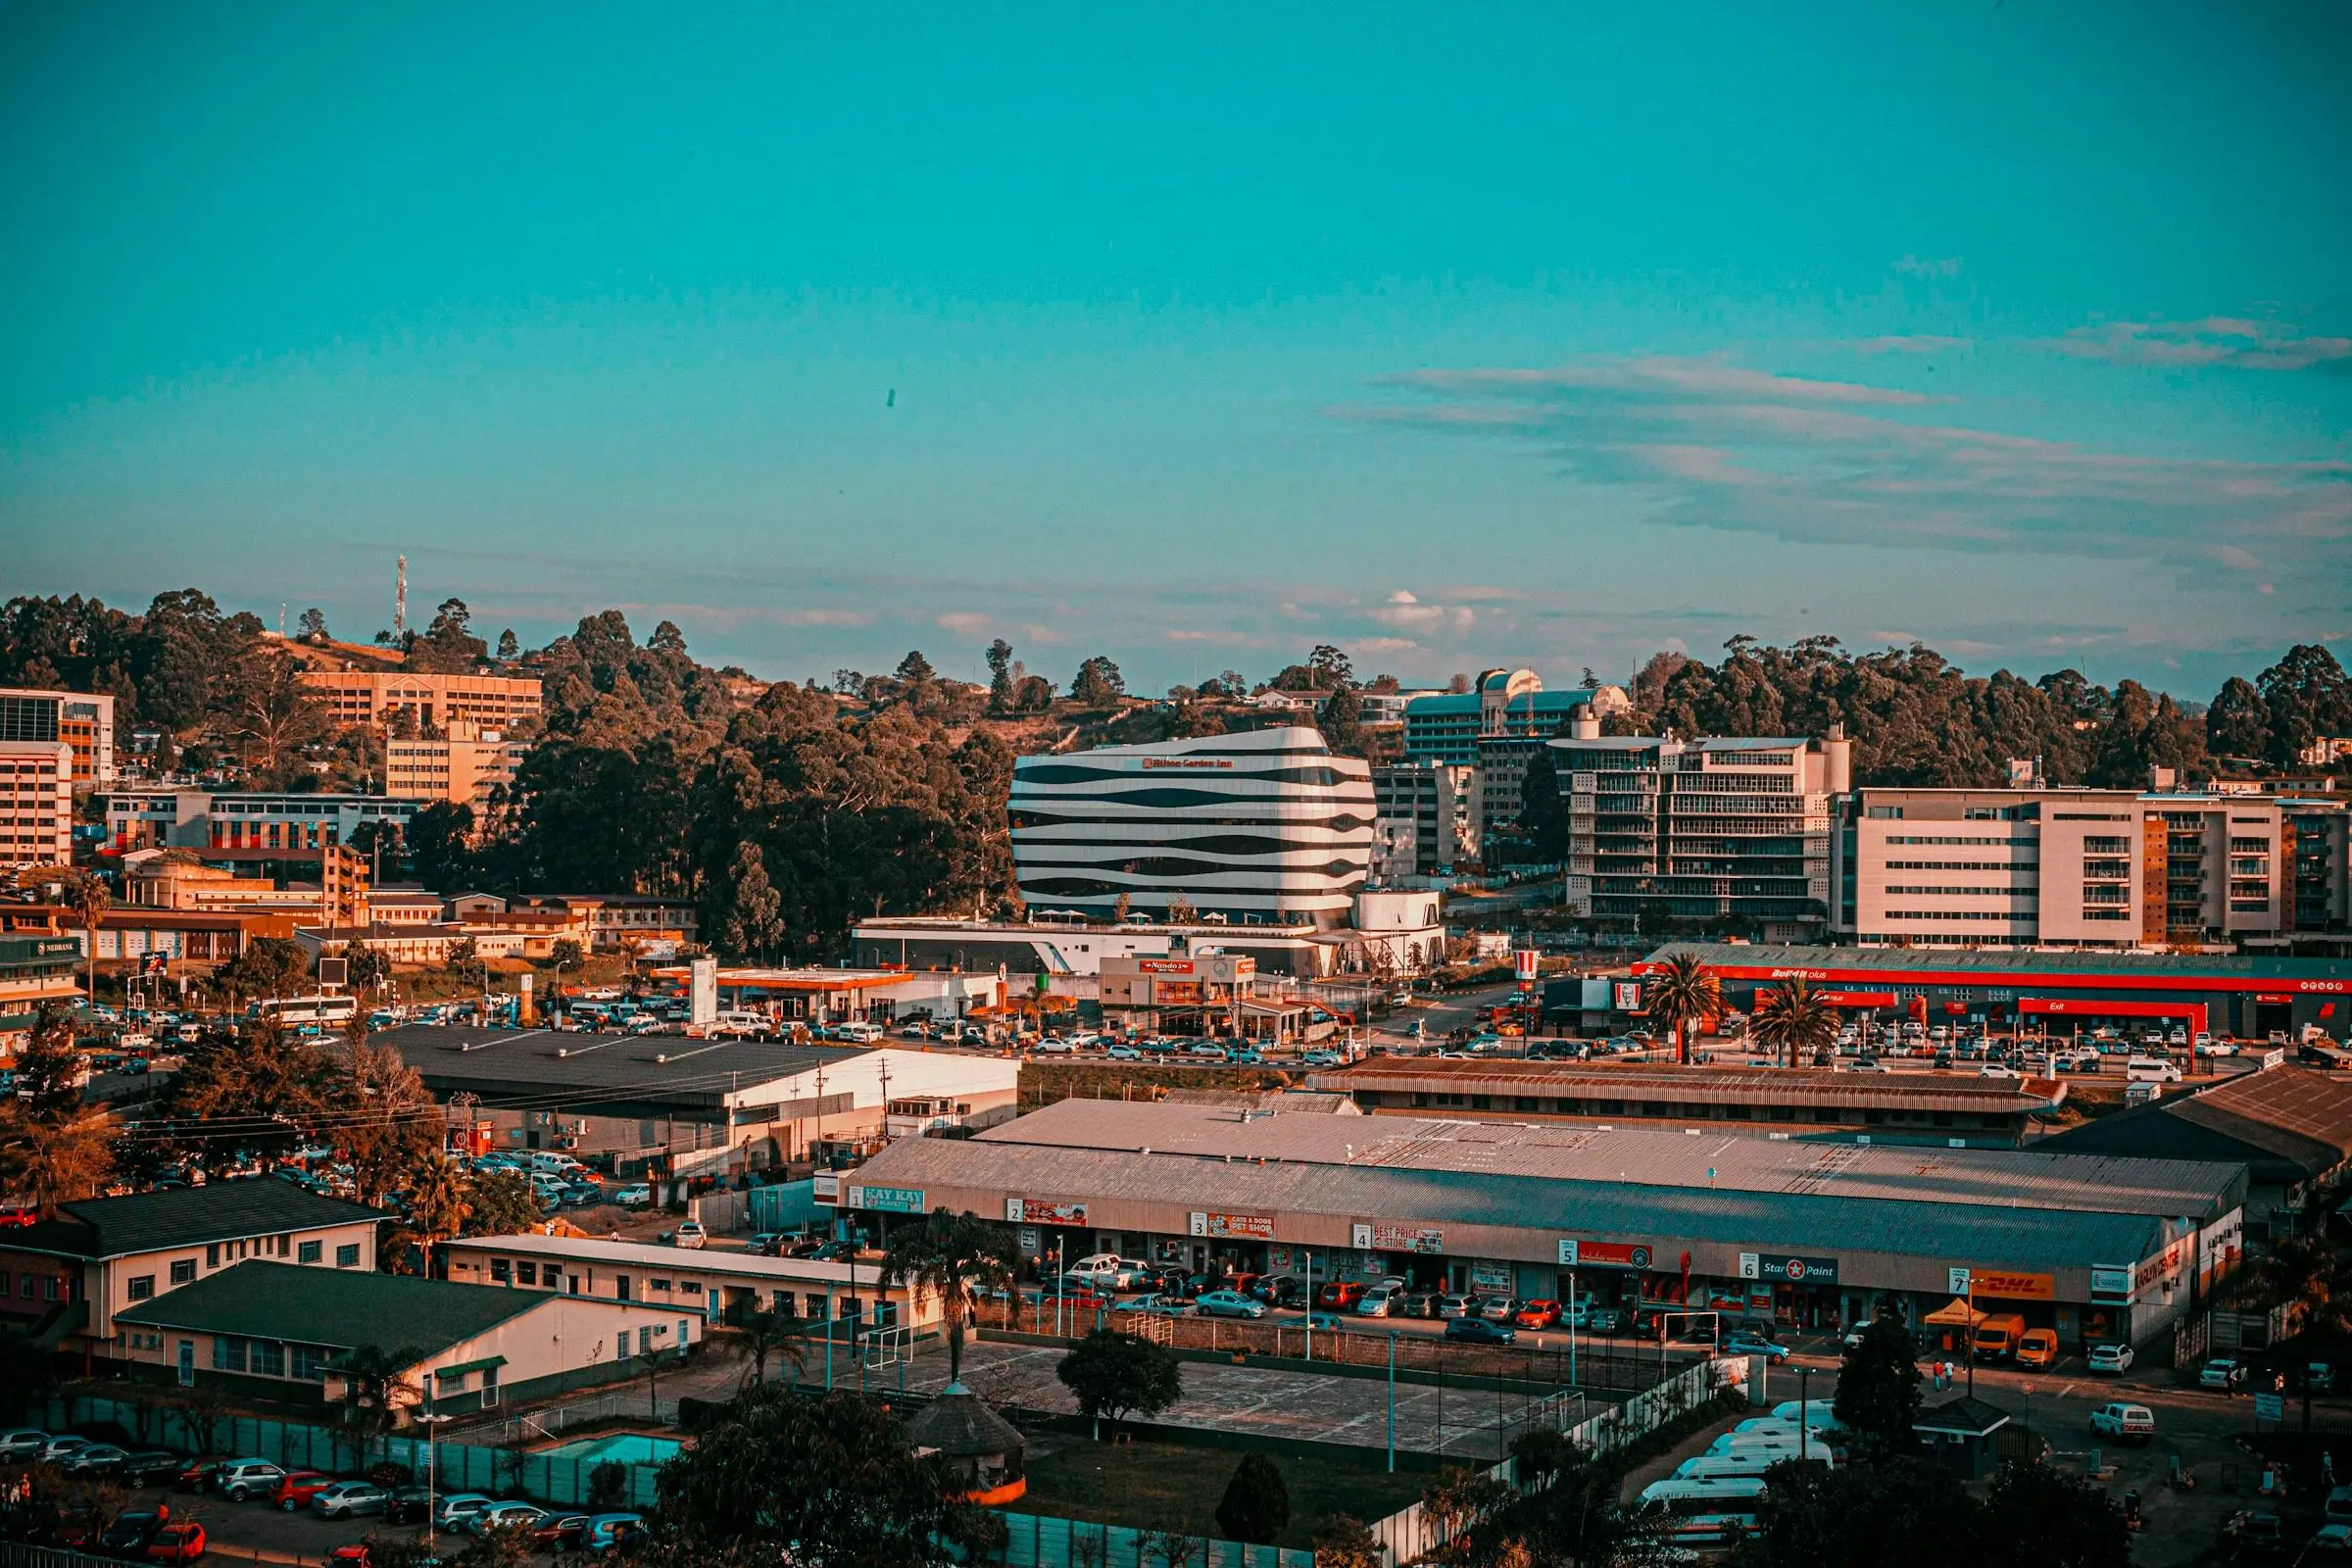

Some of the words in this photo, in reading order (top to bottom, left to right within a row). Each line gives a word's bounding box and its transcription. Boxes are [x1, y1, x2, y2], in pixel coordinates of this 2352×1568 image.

[1153, 759, 1181, 767] Hilton
[854, 1196, 859, 1205] 1
[865, 1188, 894, 1200] KAY
[896, 1190, 921, 1201] KAY
[1011, 1208, 1018, 1219] 2
[1195, 1223, 1202, 1234] 3
[1249, 1224, 1272, 1233] SHOP
[1374, 1226, 1393, 1237] BEST
[1396, 1228, 1418, 1239] PRICE
[1358, 1235, 1366, 1246] 4
[1385, 1238, 1408, 1248] STORE
[1564, 1250, 1572, 1262] 5
[2158, 1250, 2179, 1275] CENTRE
[1745, 1263, 1753, 1276] 6
[1764, 1262, 1785, 1273] Star
[1806, 1265, 1834, 1276] Paint
[1954, 1278, 1963, 1291] 7
[1986, 1277, 2036, 1293] DHL
